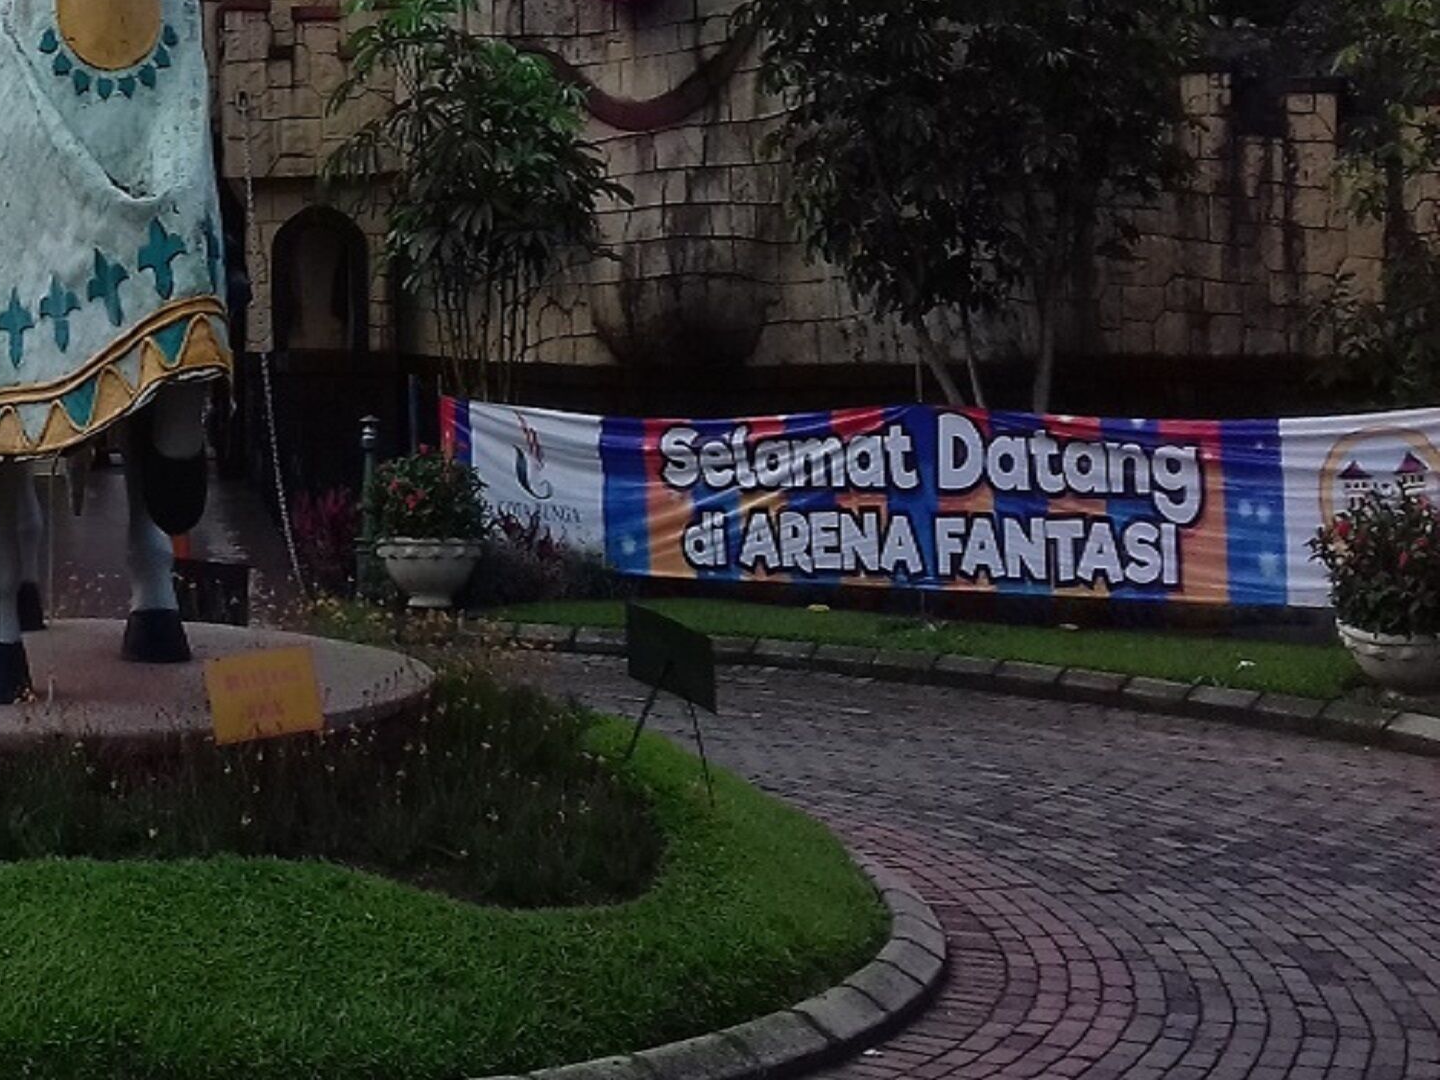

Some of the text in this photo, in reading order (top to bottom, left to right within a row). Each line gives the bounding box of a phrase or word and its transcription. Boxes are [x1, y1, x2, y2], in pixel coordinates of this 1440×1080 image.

[661, 413, 1201, 524] Selamat Datang
[683, 512, 1179, 586] di ARENA FANTASI
